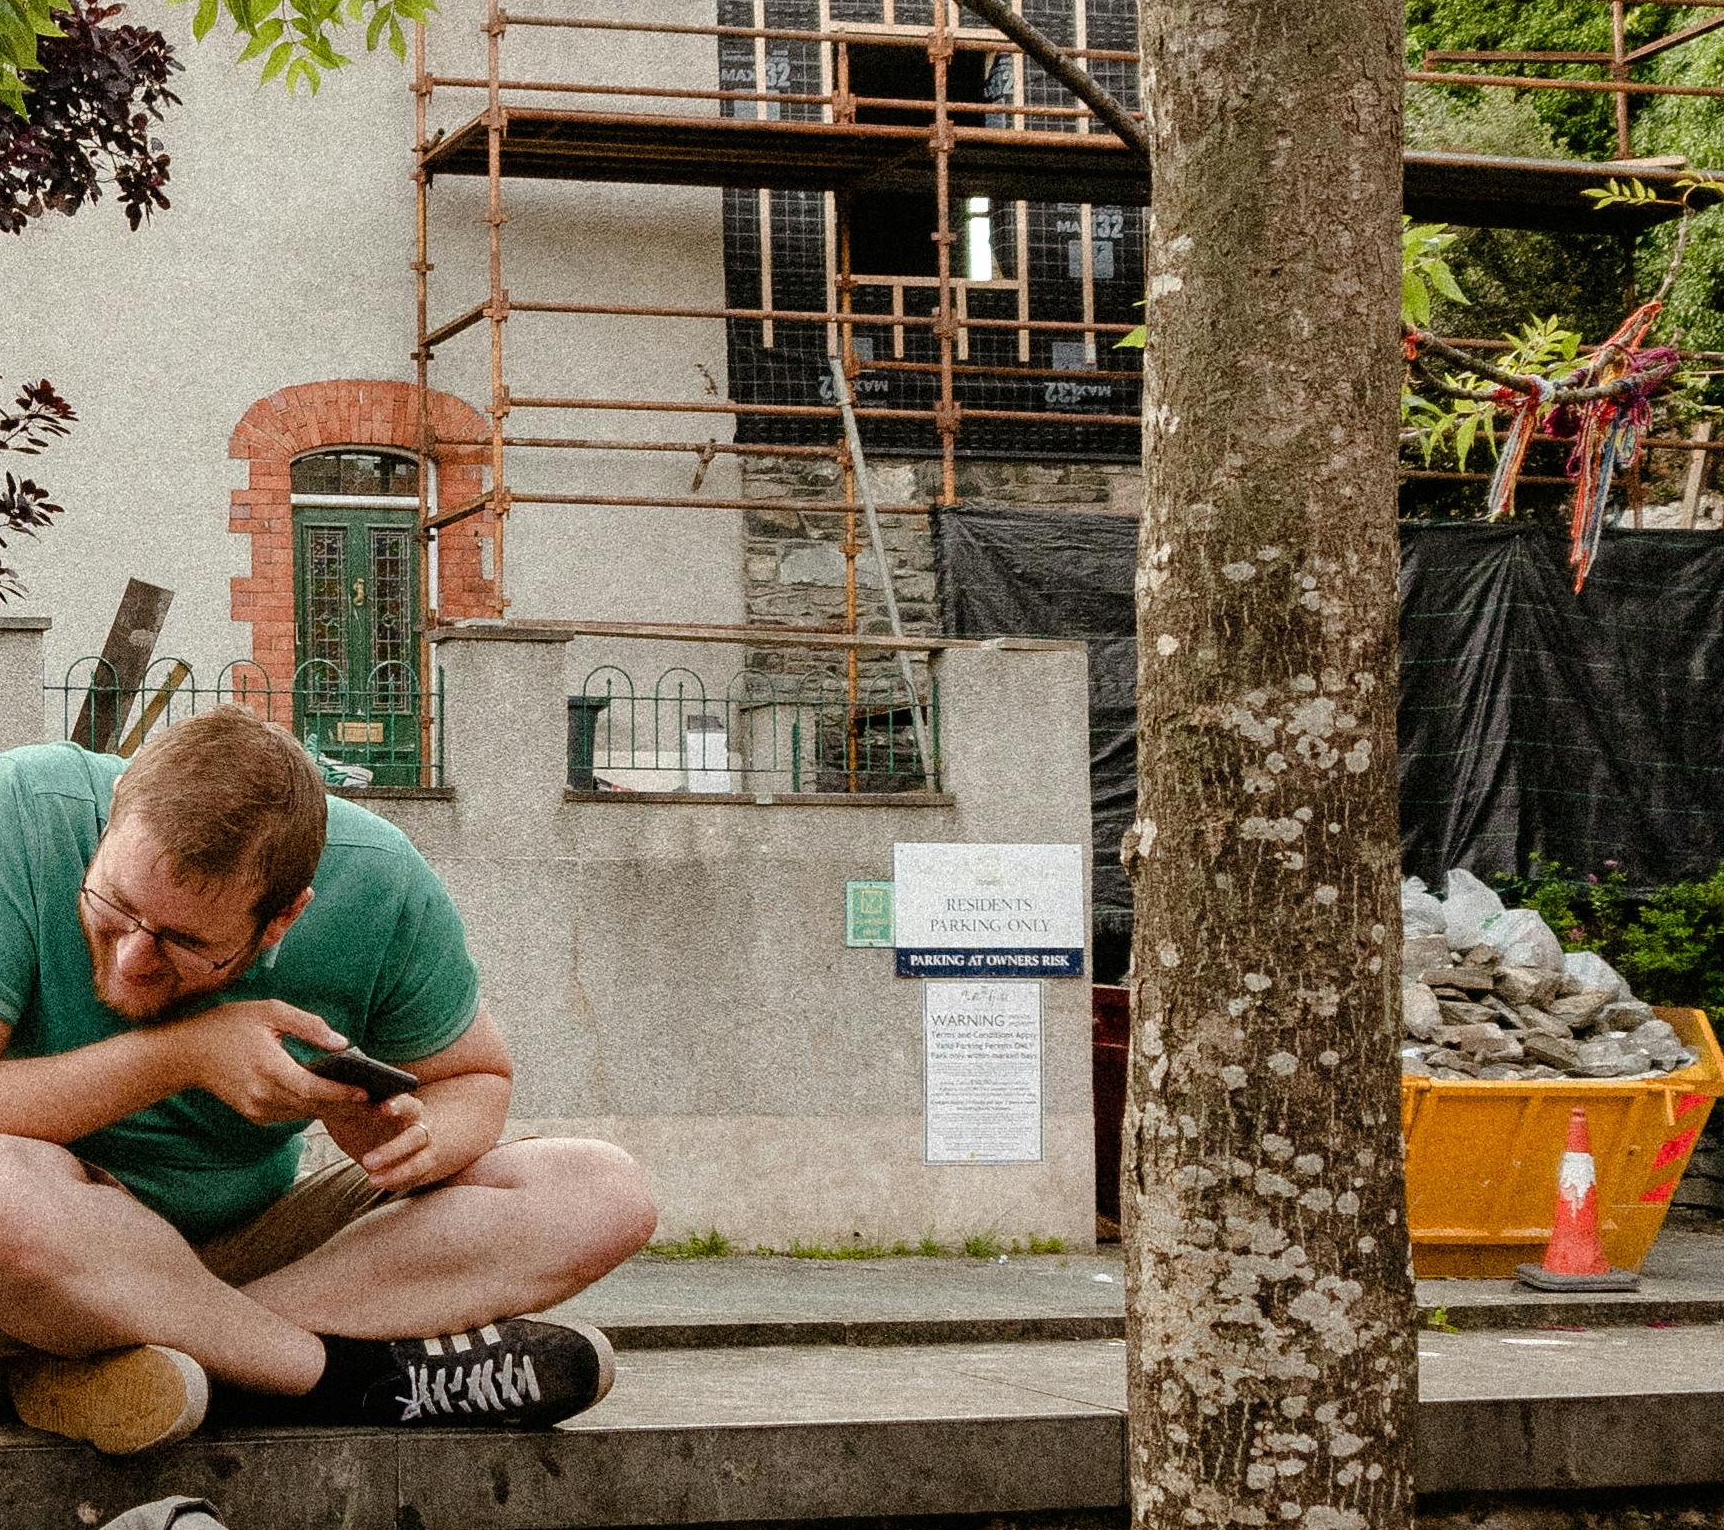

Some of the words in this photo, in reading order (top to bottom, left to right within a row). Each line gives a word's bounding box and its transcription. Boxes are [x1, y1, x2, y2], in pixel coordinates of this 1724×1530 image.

[946, 897, 1034, 912] RESIDENTS
[930, 919, 1002, 932] PARKING
[1007, 919, 1051, 933] ONLY
[909, 954, 965, 967] PARKING
[968, 954, 984, 967] AT
[986, 954, 1040, 967] OWNERS
[1041, 954, 1070, 967] RISK
[931, 1014, 1006, 1027] WARNING
